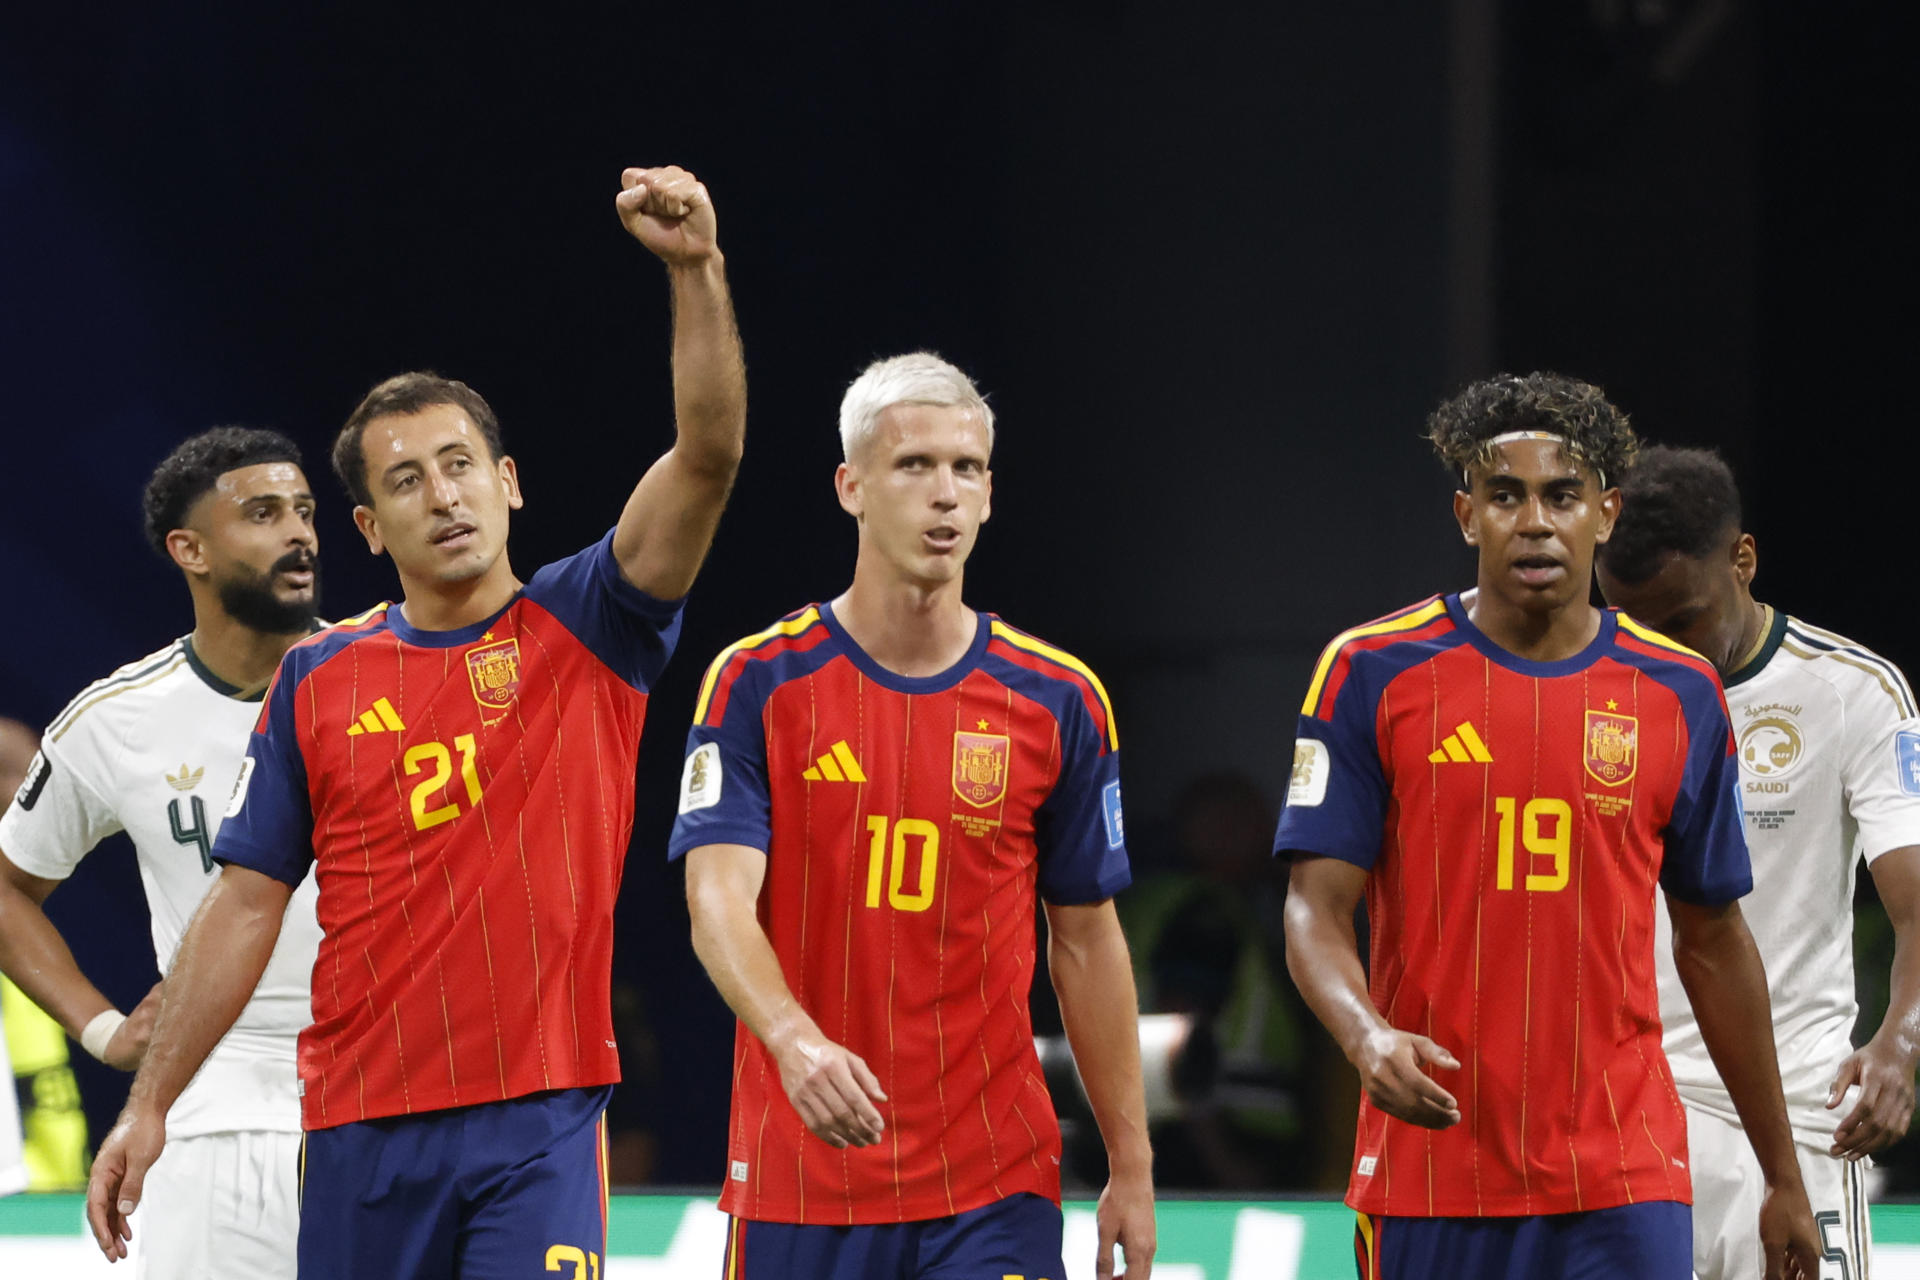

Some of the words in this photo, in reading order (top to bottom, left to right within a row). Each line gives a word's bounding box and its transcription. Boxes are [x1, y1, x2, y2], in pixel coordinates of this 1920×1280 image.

[403, 732, 483, 831] 21
[1746, 782, 1789, 793] SAUDI
[168, 795, 214, 874] 4
[866, 815, 939, 912] 10
[1496, 797, 1572, 892] 19
